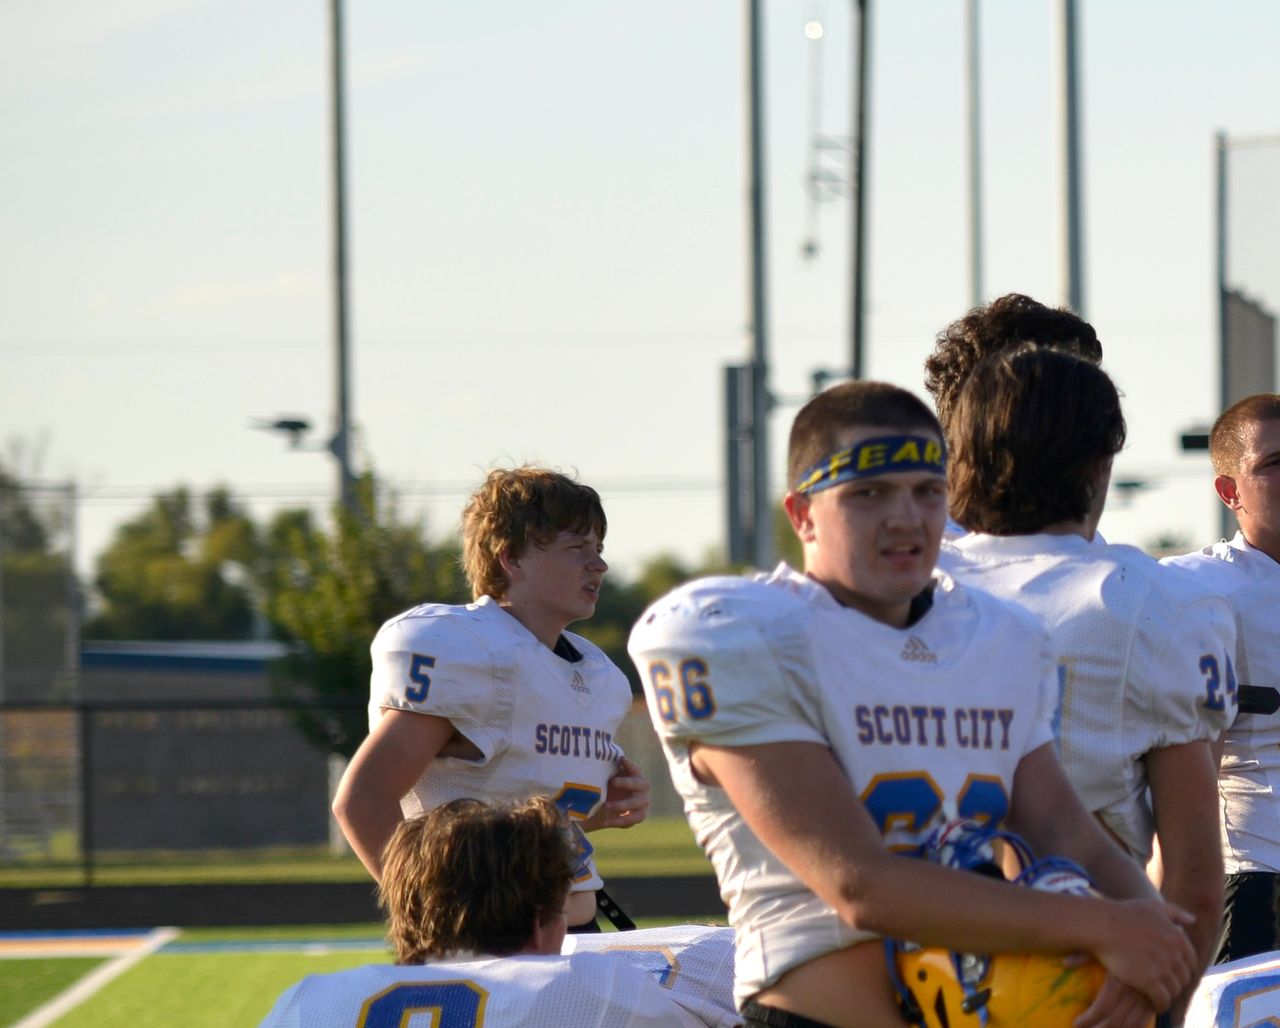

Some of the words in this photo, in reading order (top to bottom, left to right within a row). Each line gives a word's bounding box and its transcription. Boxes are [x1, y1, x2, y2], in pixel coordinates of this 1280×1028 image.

[828, 439, 942, 480] FEAR
[405, 653, 436, 704] 5
[649, 659, 716, 724] 66
[535, 723, 592, 758] SCOTT
[855, 704, 947, 748] SCOTT
[954, 708, 1015, 750] CITY
